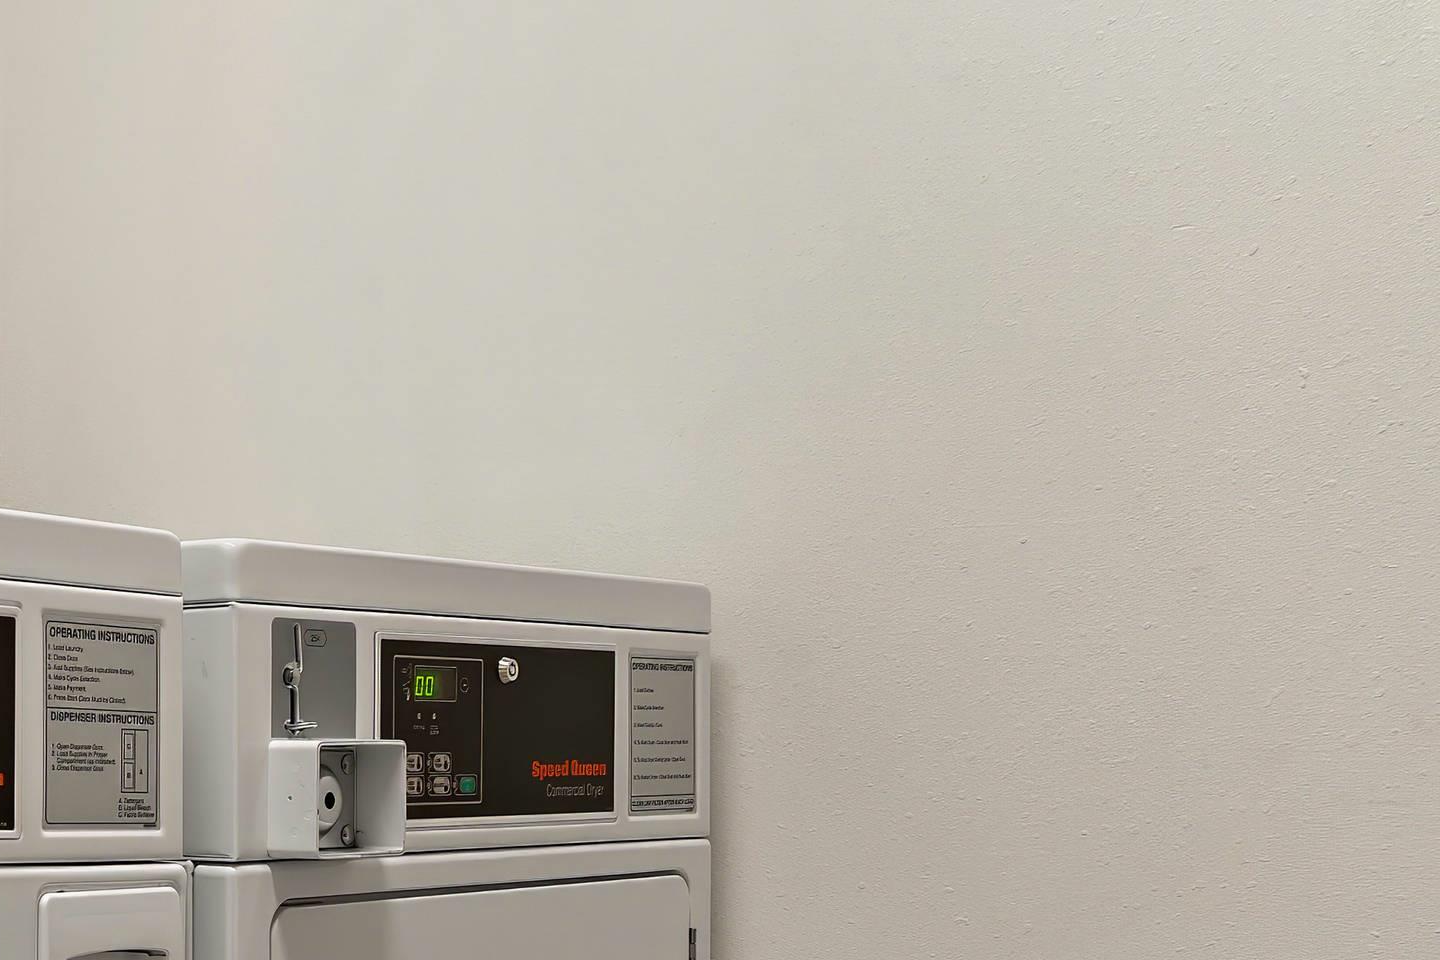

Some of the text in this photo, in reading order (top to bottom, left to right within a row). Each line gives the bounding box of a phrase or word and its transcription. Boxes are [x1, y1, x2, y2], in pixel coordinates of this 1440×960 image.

[50, 626, 154, 644] OPERATING INSTRUCTIONS
[50, 711, 154, 725] DISPENSER INSTRUCTIONS
[532, 760, 606, 780] Speed Queen
[546, 784, 604, 798] Commercial Dryer
